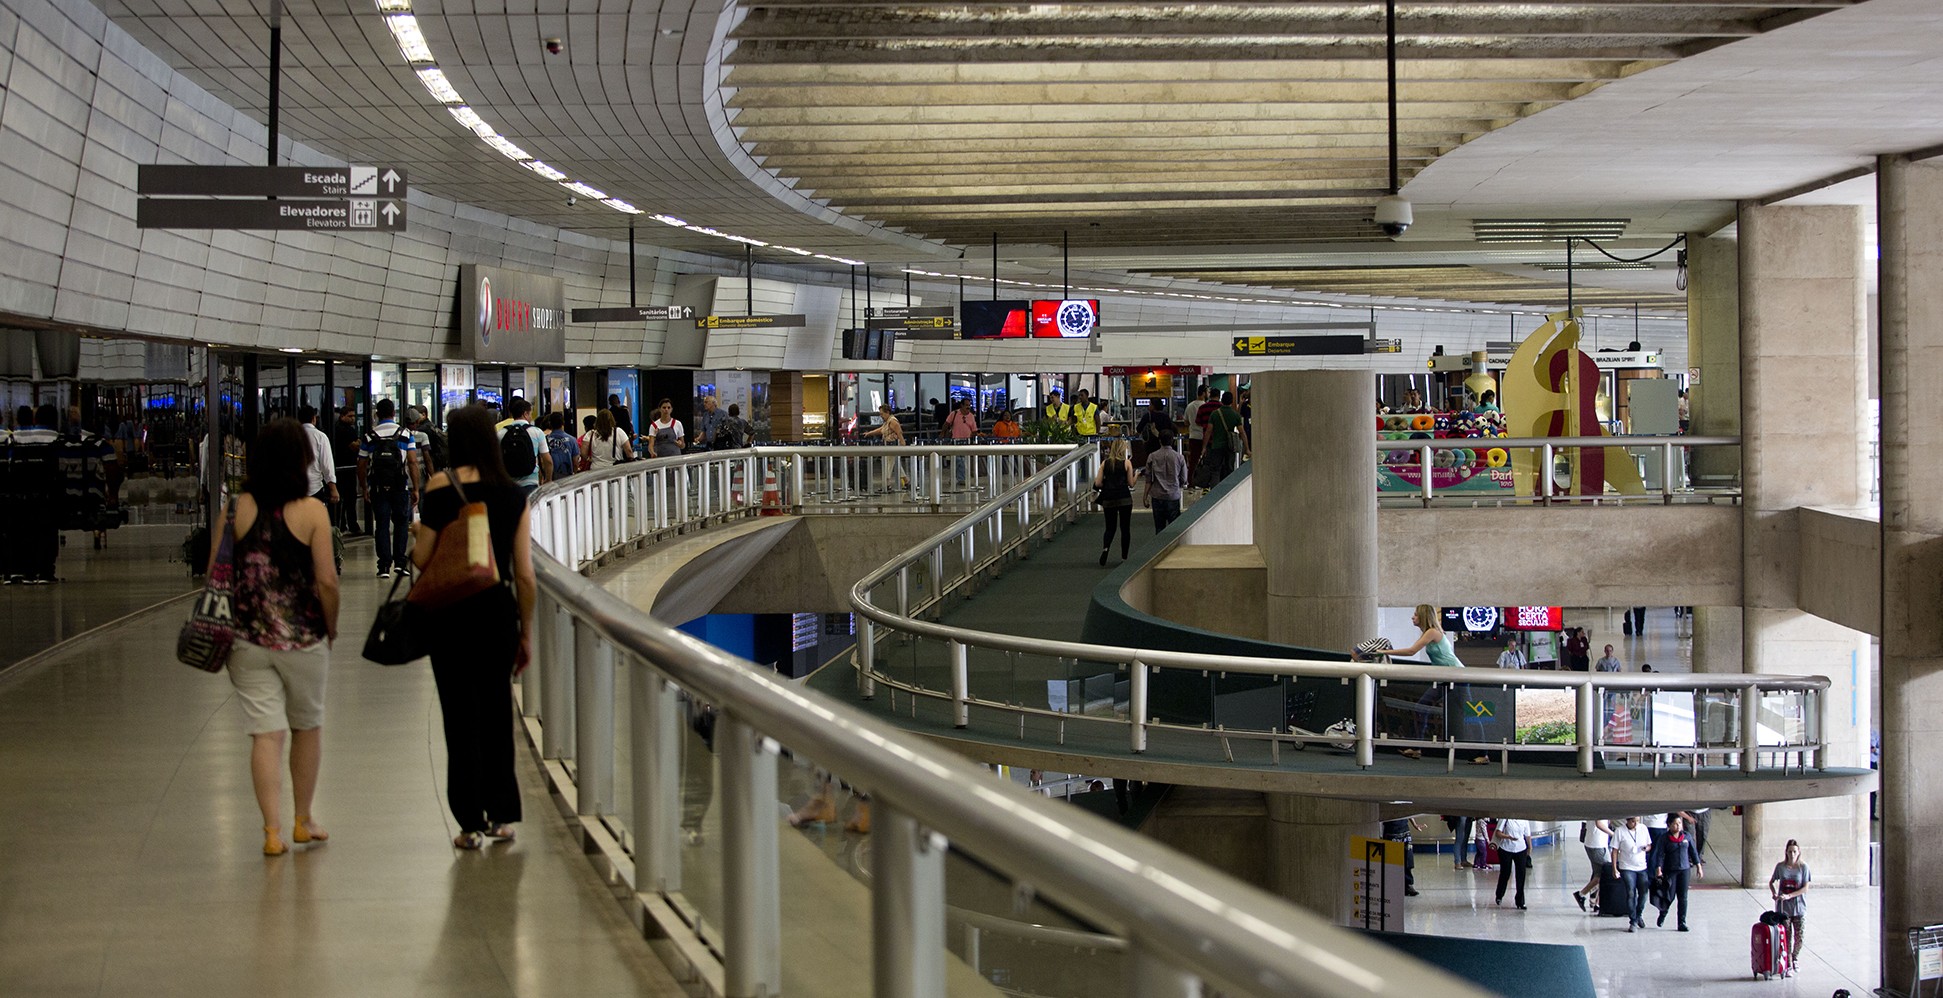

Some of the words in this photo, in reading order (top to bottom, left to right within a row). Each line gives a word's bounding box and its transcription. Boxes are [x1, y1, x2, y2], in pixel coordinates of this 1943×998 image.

[304, 173, 346, 183] Escada
[323, 185, 347, 194] Stairs
[279, 205, 346, 217] Elevadores
[306, 218, 347, 227] Elevators
[496, 298, 530, 333] DUFRY
[532, 307, 565, 330] SHOPPING
[1518, 611, 1548, 620] CERTA
